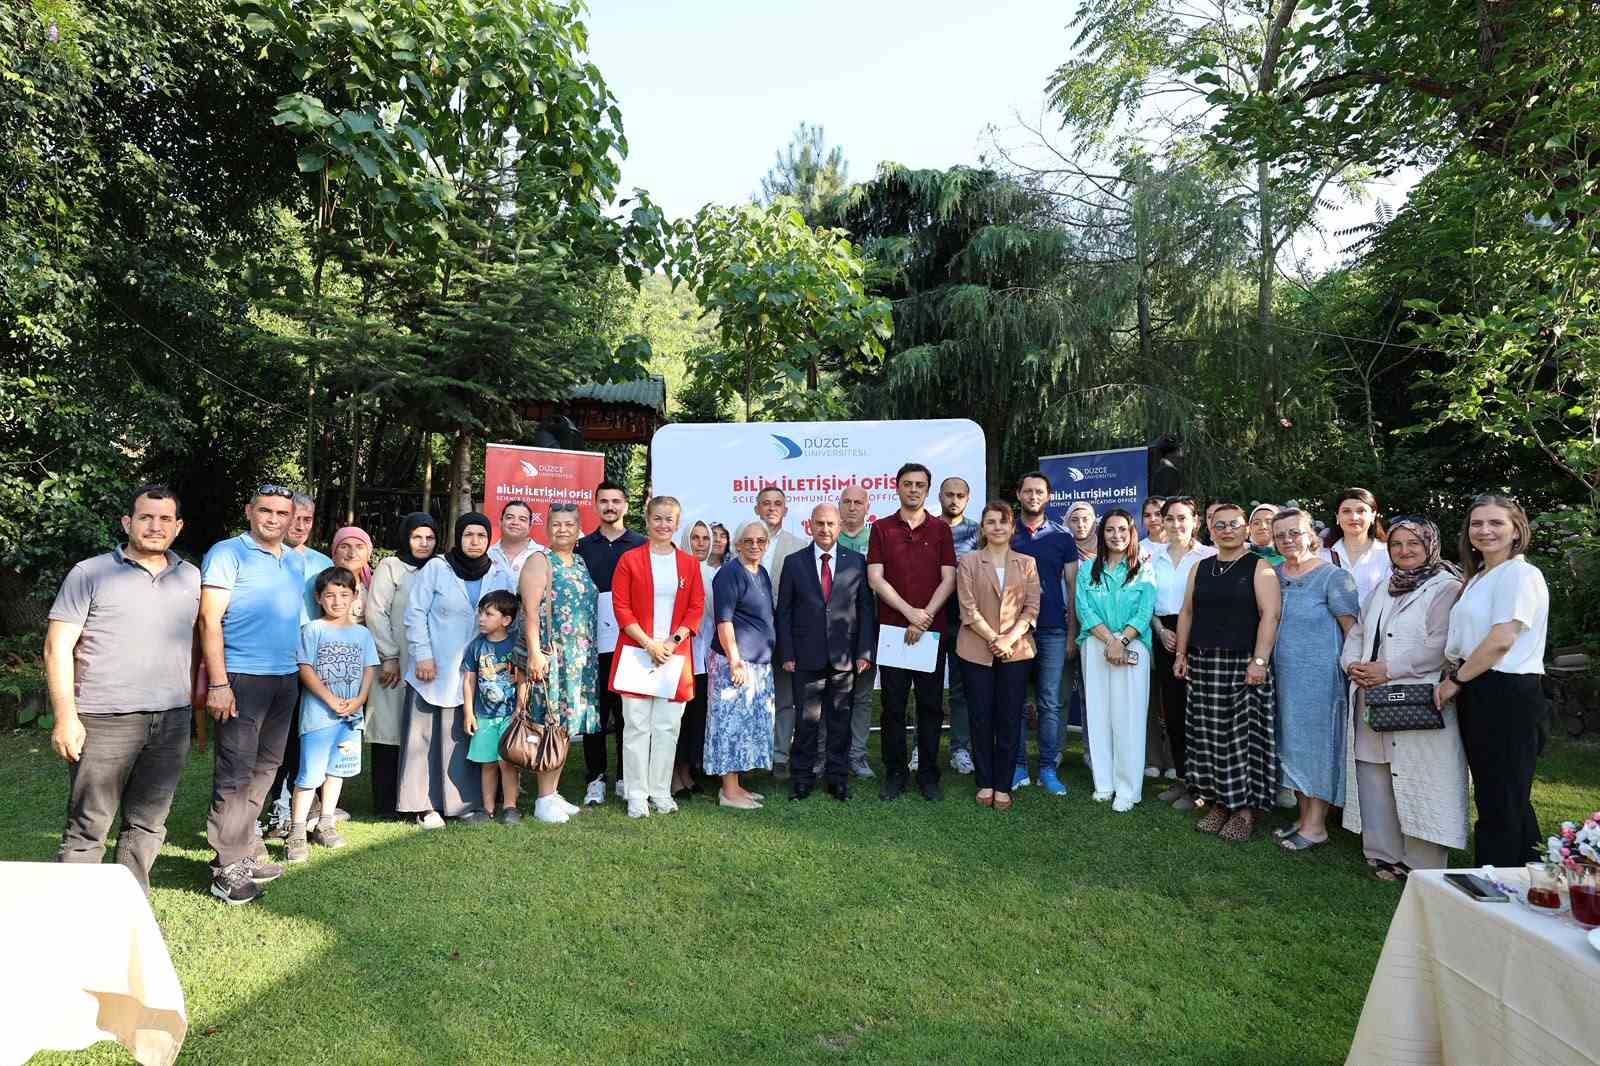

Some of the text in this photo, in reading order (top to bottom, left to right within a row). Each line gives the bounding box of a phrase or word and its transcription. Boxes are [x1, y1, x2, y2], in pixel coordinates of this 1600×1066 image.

[861, 473, 898, 490] OFİS
[732, 493, 898, 504] SCIE OMMUNICA OFFIC
